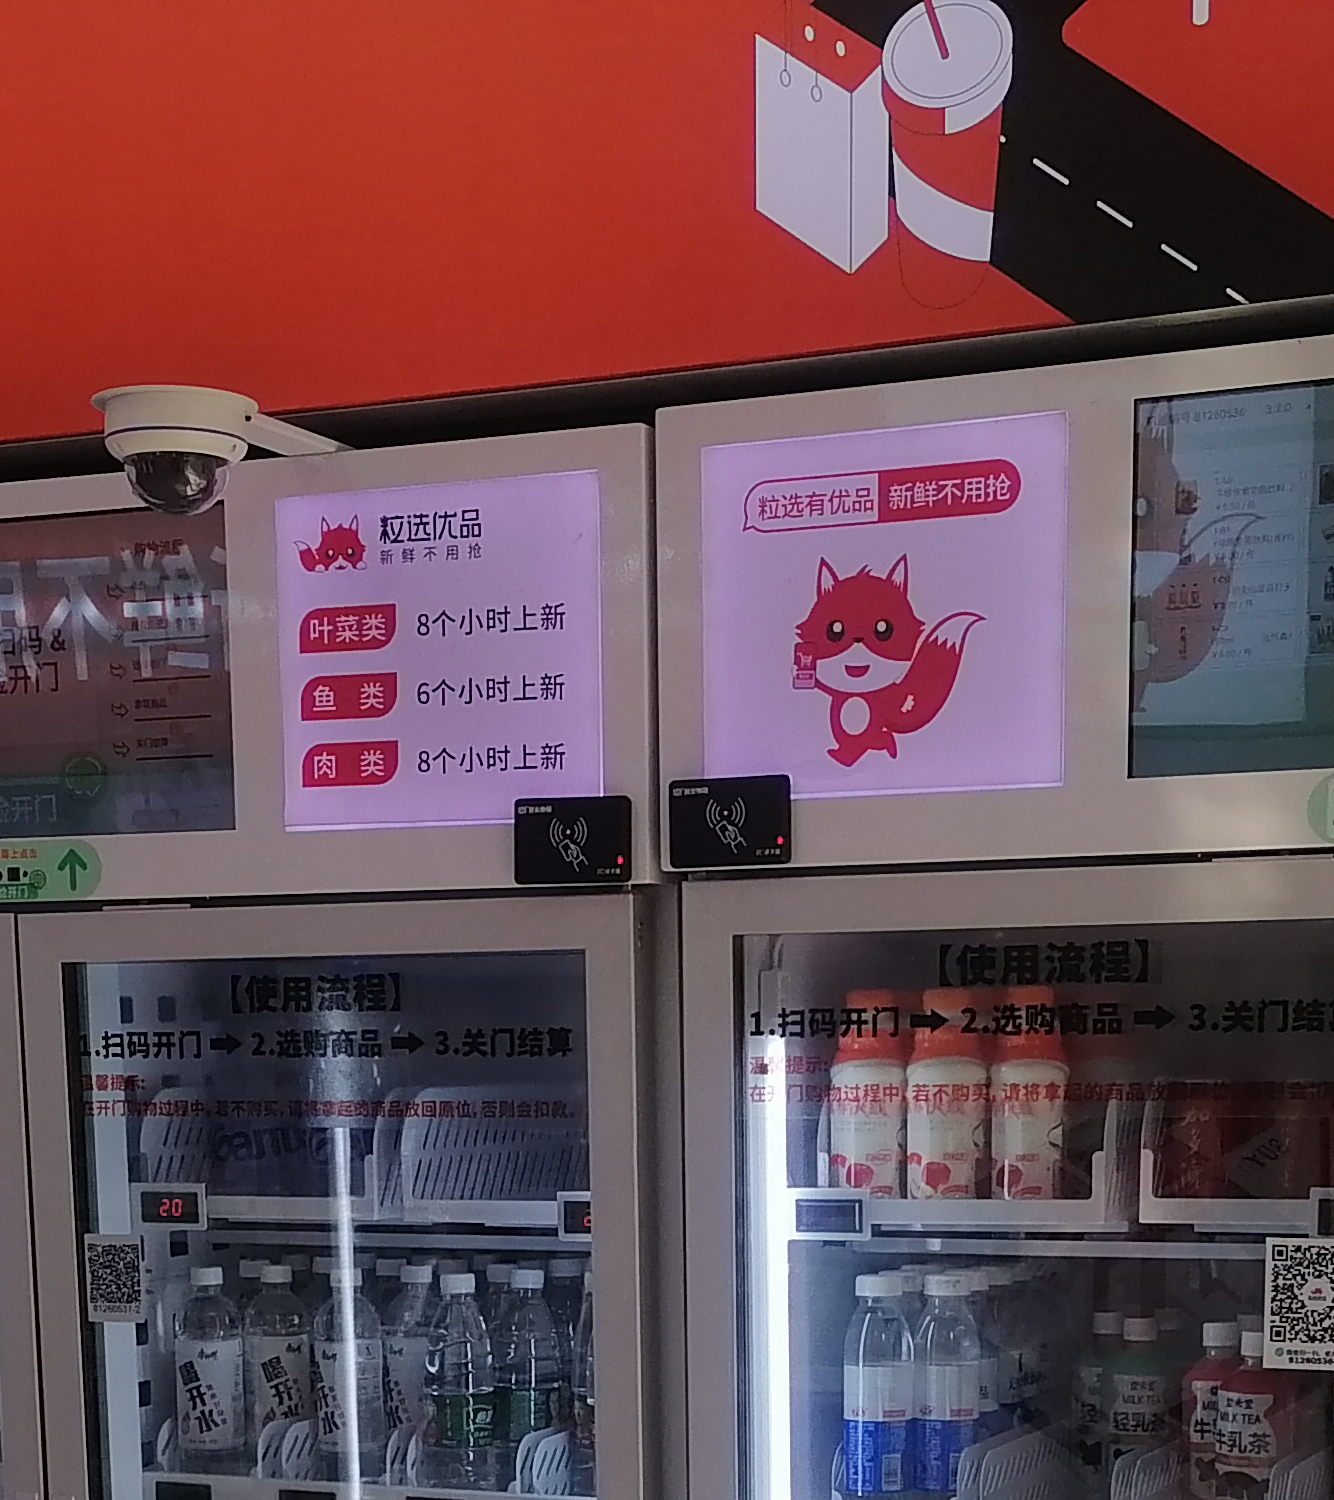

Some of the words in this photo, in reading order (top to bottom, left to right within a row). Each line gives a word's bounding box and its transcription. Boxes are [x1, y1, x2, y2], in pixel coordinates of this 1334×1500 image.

[758, 487, 874, 521] 粒选有优品
[888, 473, 1012, 510] 新鲜不用抢
[379, 508, 482, 544] 粒选优品
[380, 543, 482, 565] 新鲜不用抢
[310, 613, 386, 644] 叶菜类
[417, 603, 566, 636] 8个小时上新
[417, 673, 565, 706] 6个小时上新
[418, 743, 566, 774] 8个小时上新
[934, 938, 1153, 988] 【使用流程】
[229, 974, 402, 1013] 【使用流程】
[749, 1008, 900, 1039] 1.扫码开门
[959, 1003, 1123, 1036] 2.选购商品
[251, 1029, 383, 1058] 2.选购商品
[435, 1027, 573, 1058] 3.关门结算
[1241, 1413, 1261, 1424] TEA
